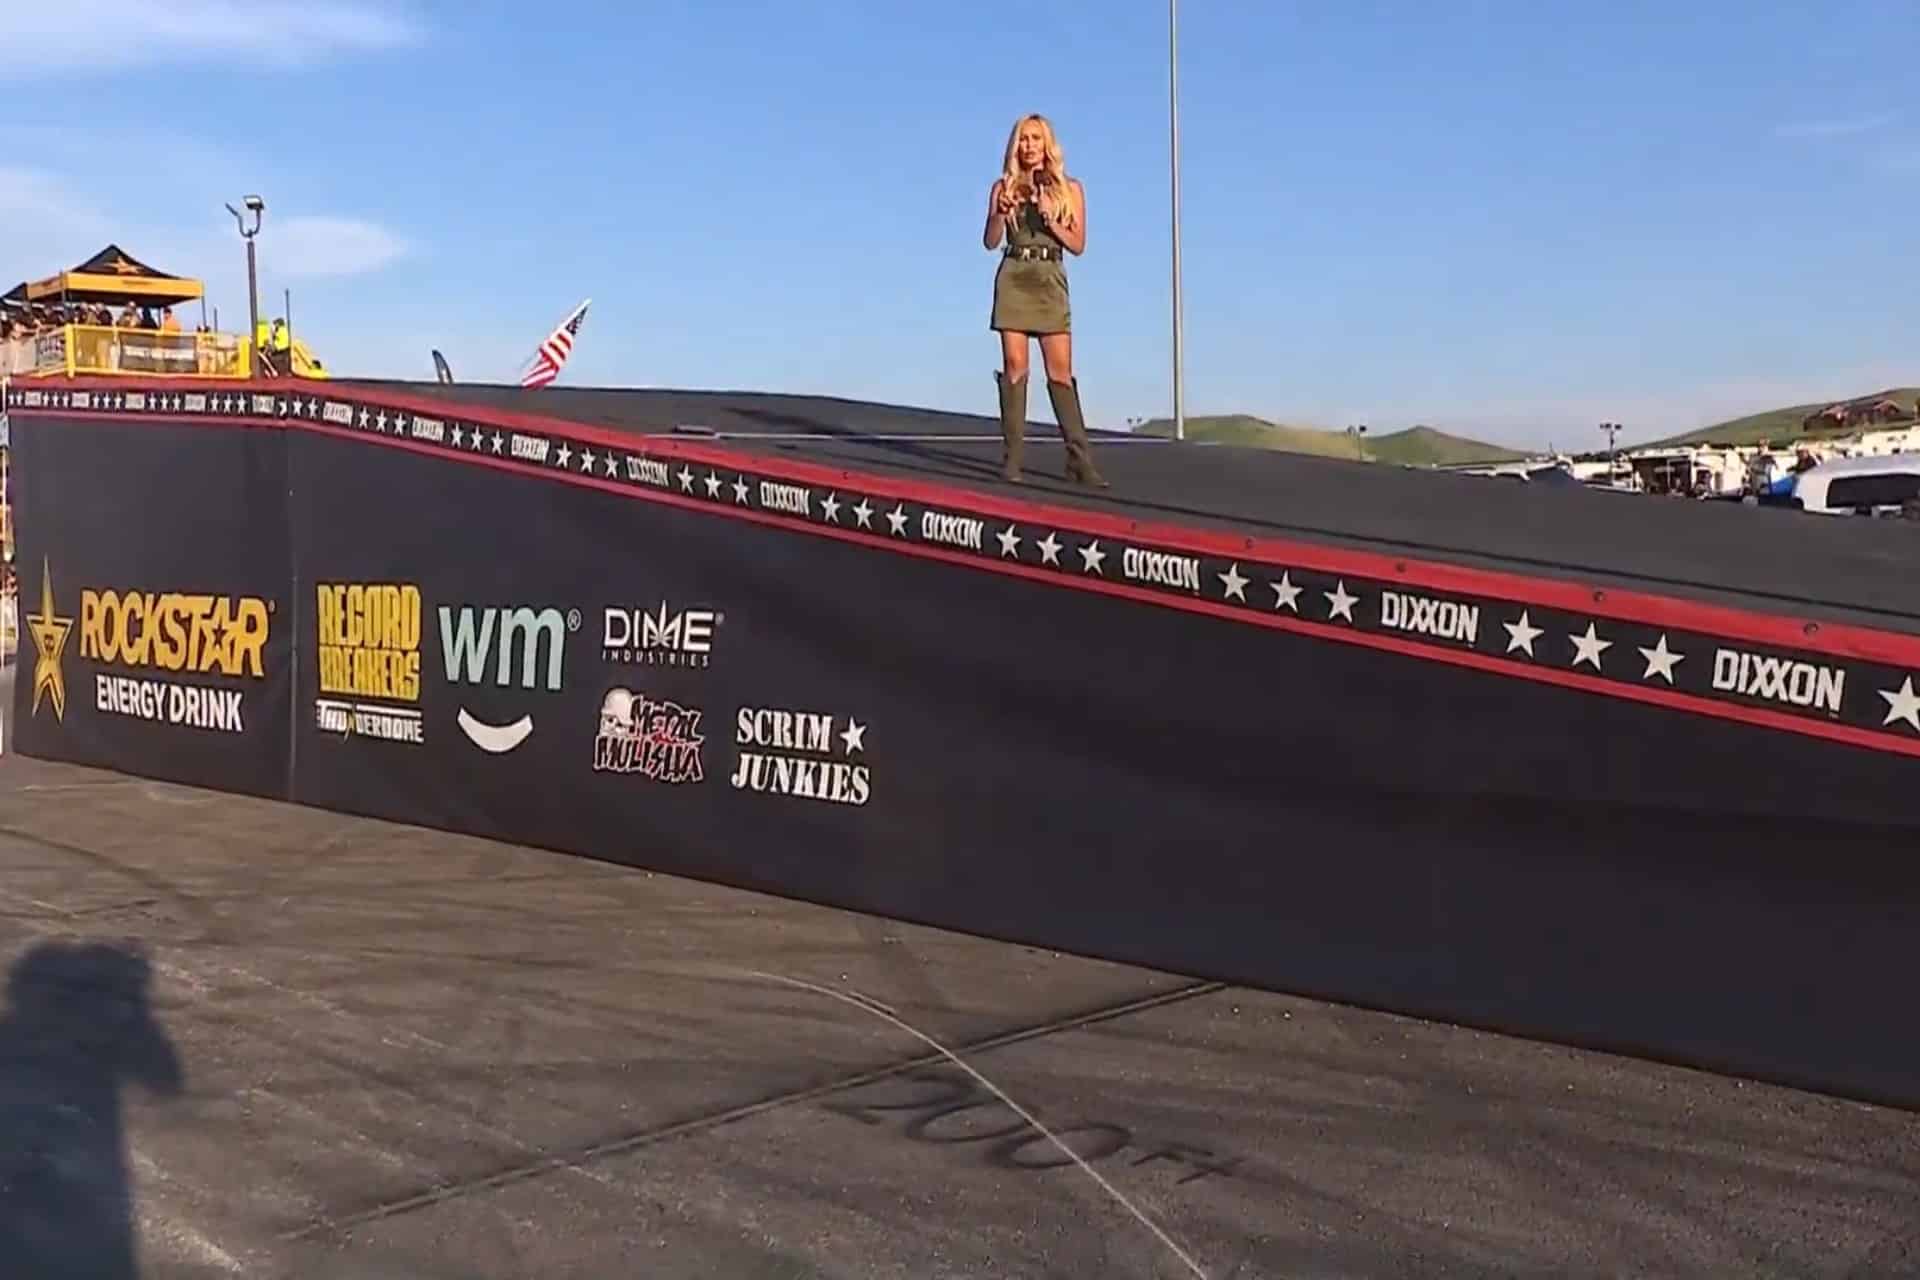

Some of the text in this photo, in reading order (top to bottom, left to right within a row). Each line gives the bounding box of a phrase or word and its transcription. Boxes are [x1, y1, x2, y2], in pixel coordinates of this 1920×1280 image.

[626, 455, 668, 487] DIXXON
[760, 481, 810, 517] DIXXON
[922, 511, 983, 549] DIXXON
[1123, 548, 1199, 592] DIXXON
[1382, 591, 1478, 642] DIXXON
[1713, 648, 1844, 711] DIXXON
[80, 590, 270, 678] ROCKSTAR
[317, 584, 421, 650] RECORD
[604, 600, 714, 652] DIME
[319, 645, 420, 701] BREAKERS
[602, 649, 710, 668] INDUSTRIES
[96, 675, 243, 732] ENERGY DRINK
[736, 707, 832, 753] SCRIM
[731, 752, 870, 806] JUNKIES
